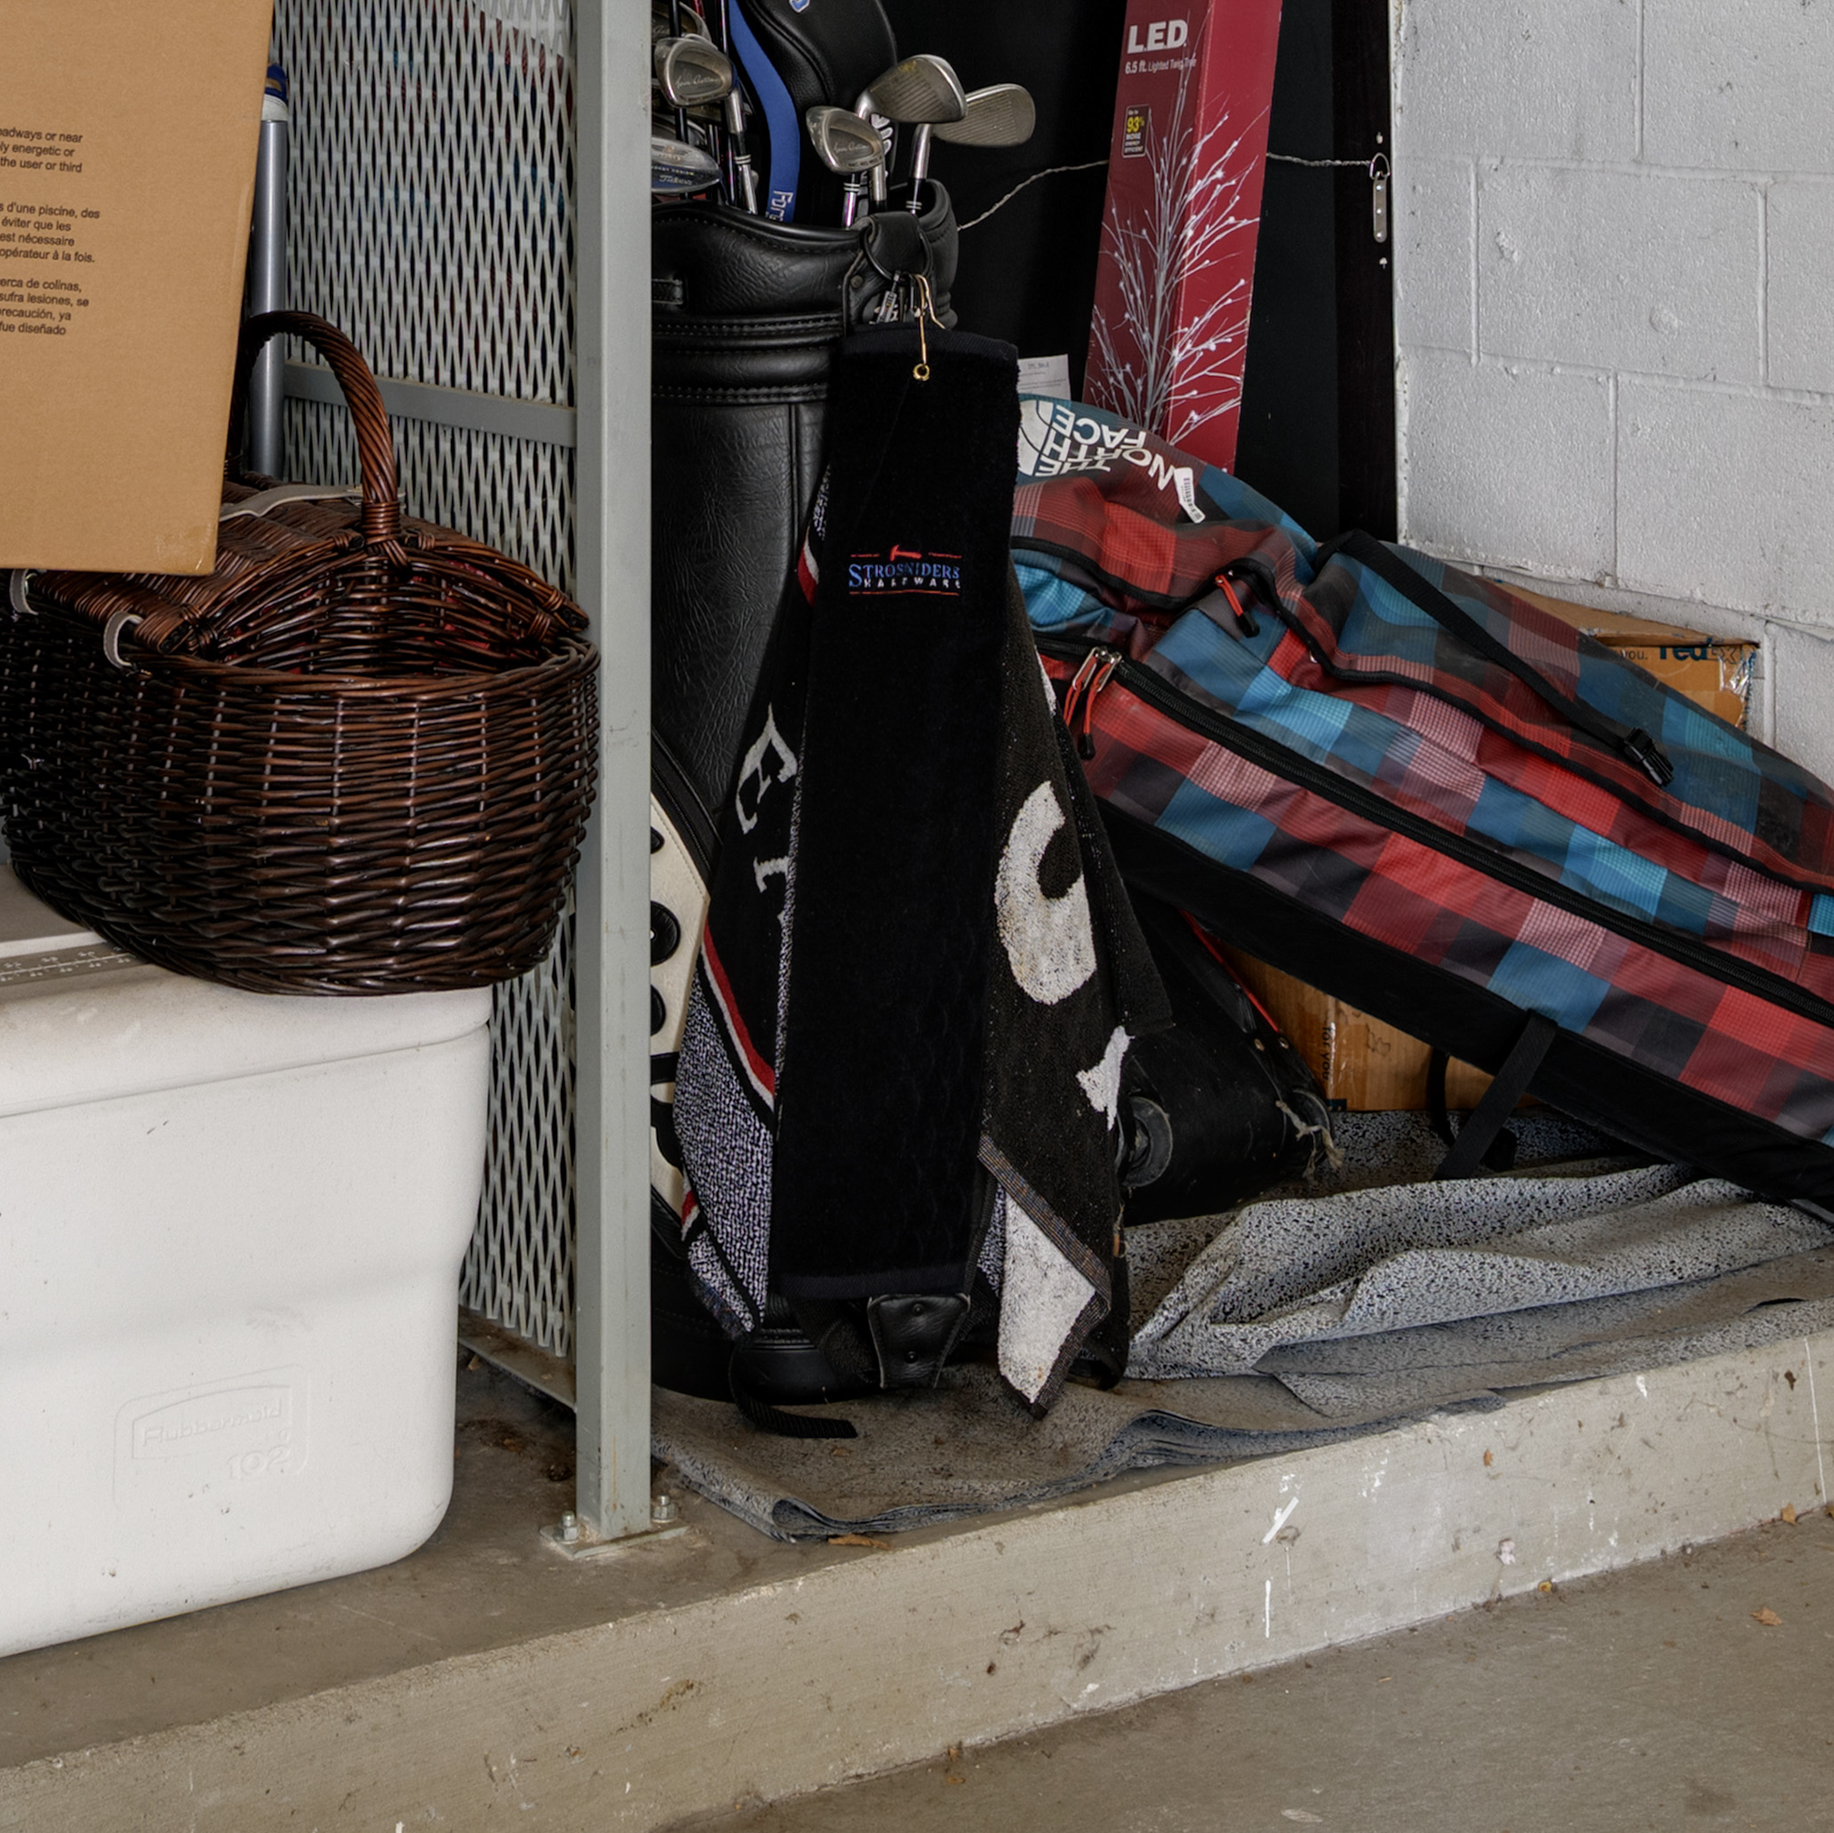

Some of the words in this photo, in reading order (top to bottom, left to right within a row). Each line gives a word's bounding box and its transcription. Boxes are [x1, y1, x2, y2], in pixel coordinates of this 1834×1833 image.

[1125, 61, 1138, 75] 6.5
[1148, 59, 1169, 73] Lighted
[44, 132, 57, 141] or
[58, 133, 83, 143] near
[1051, 404, 1147, 450] FACE
[848, 563, 960, 587] STROSNIDERS
